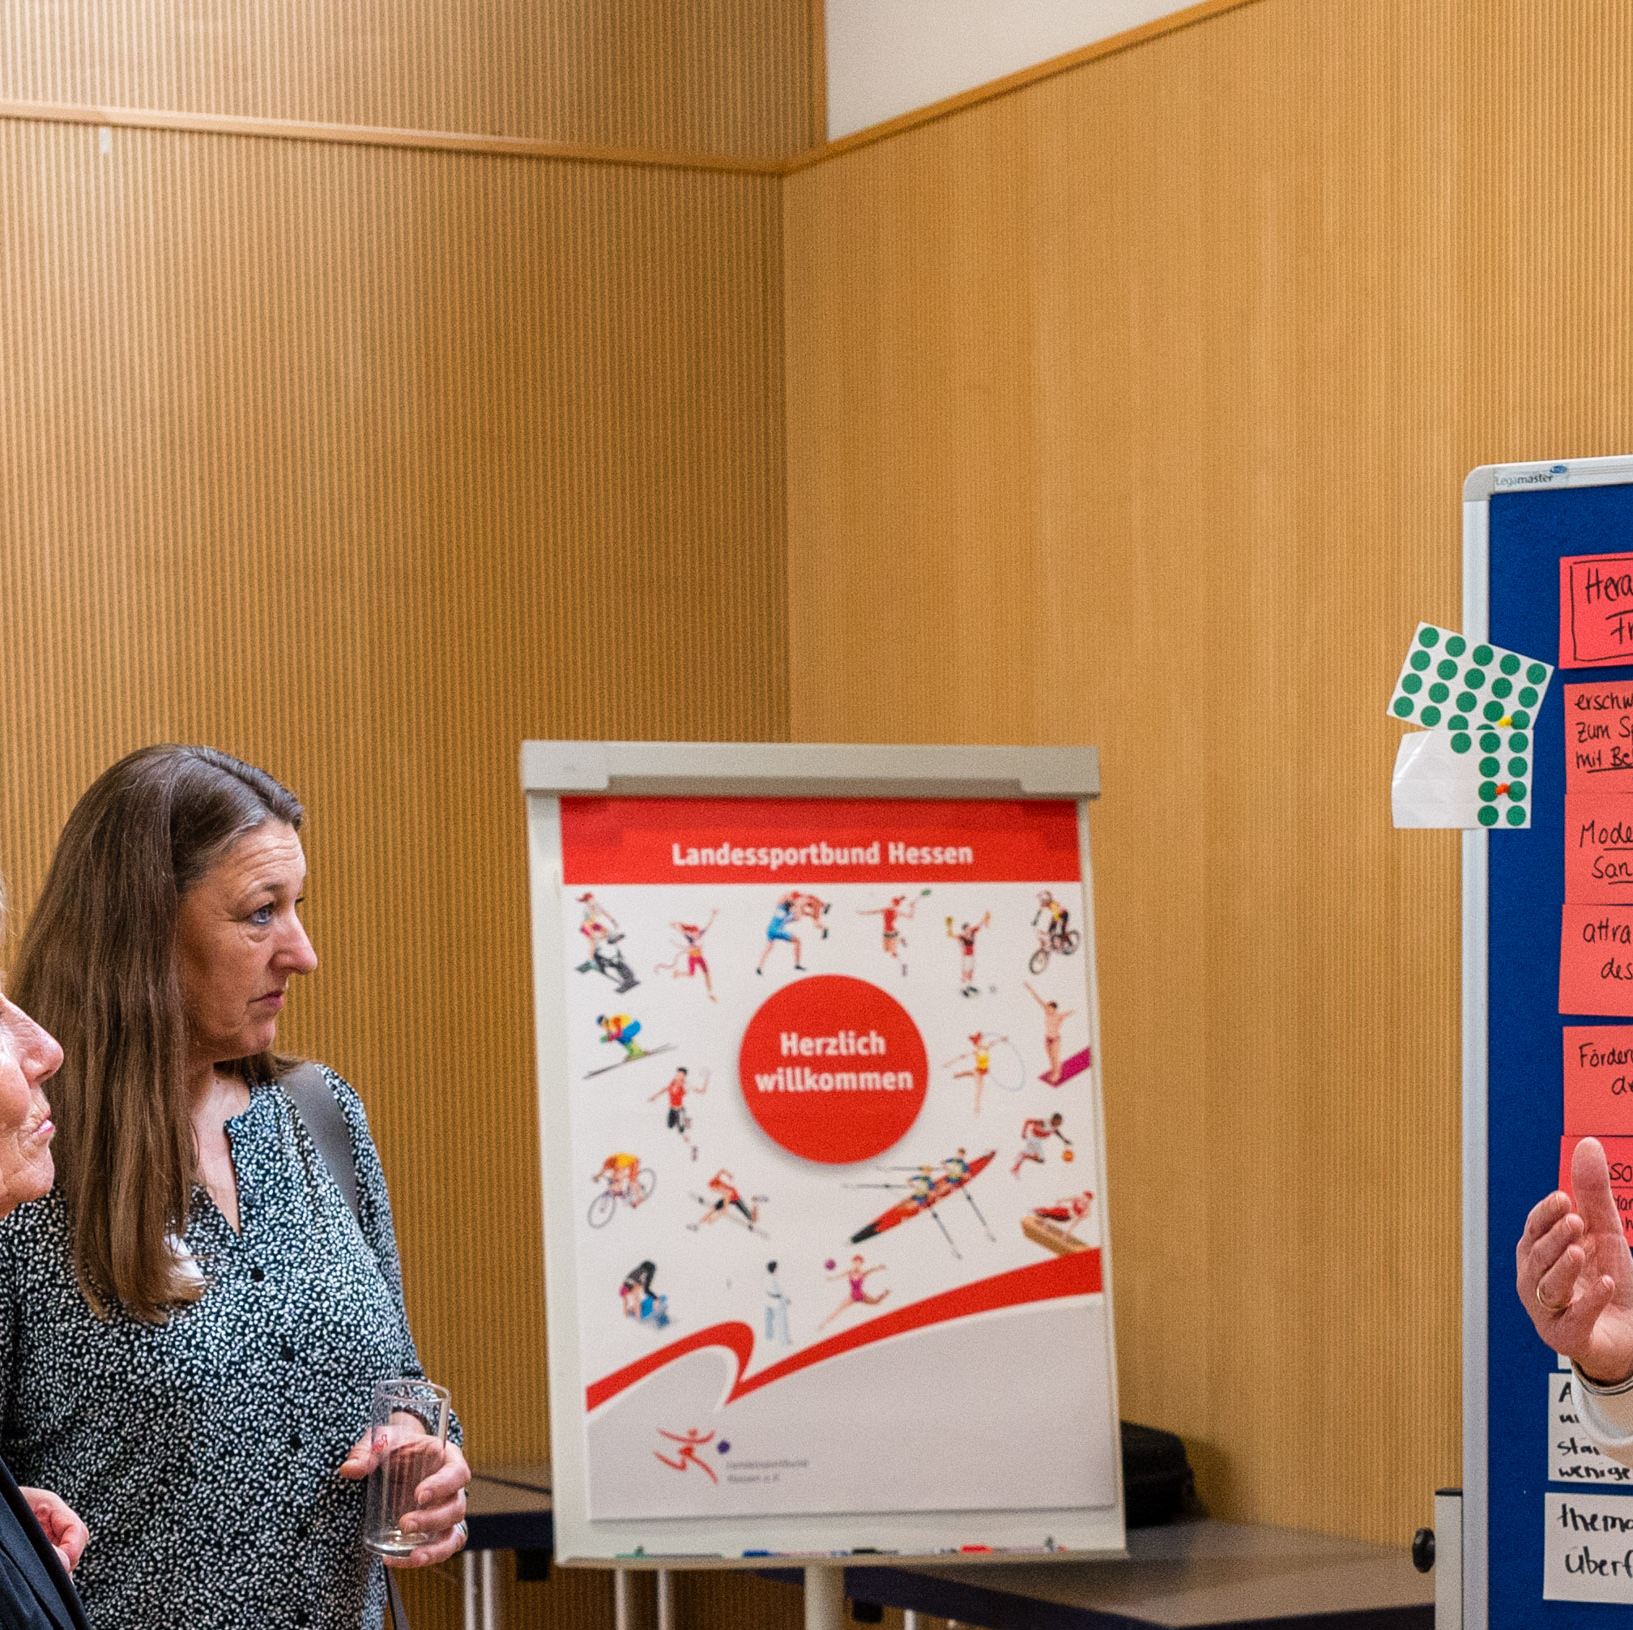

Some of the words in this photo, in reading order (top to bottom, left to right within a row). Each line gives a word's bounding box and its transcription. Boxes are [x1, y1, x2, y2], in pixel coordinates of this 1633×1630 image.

[1576, 748, 1602, 769] mit
[672, 842, 880, 870] Landessportbund
[888, 843, 973, 865] Hessen
[1601, 957, 1633, 980] des
[780, 1031, 886, 1056] Herzlich
[755, 1067, 914, 1092] willkommen
